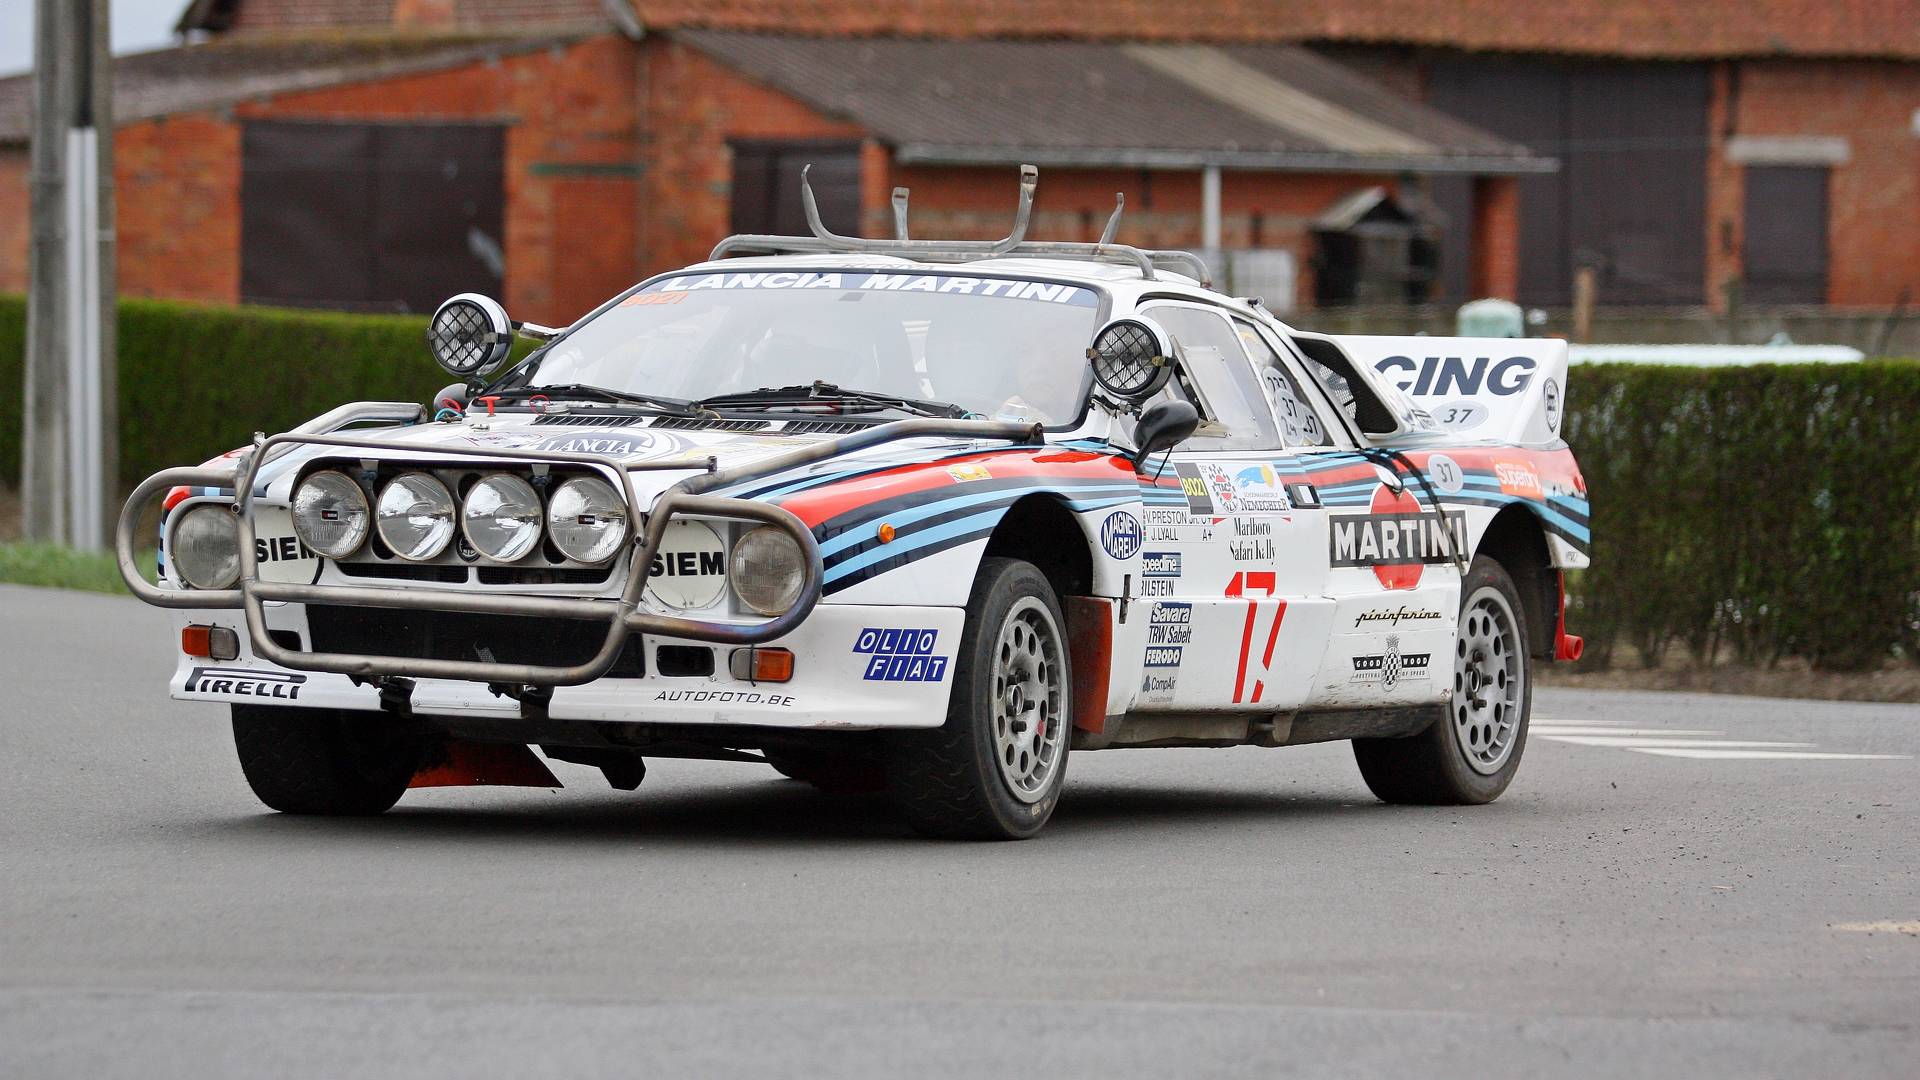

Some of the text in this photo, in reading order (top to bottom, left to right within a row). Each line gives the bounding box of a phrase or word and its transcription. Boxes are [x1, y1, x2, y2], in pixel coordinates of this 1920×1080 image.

[661, 272, 1078, 303] LANCIA MARTINI
[1443, 408, 1473, 424] 37
[543, 439, 632, 454] LANCIA
[1435, 462, 1455, 483] 37
[1145, 510, 1187, 525] V.PRESTON
[1234, 517, 1271, 536] Marlboro
[1151, 528, 1213, 541] J.LYALL A+
[1334, 516, 1464, 561] MARTINI
[1230, 540, 1253, 561] Safari
[649, 552, 724, 577] SIEM
[1152, 602, 1190, 623] Savara
[1355, 605, 1442, 628] pininfarina
[859, 630, 934, 651] OLIO
[1149, 625, 1192, 643] TRW Sabelt
[1145, 649, 1180, 664] FERODO
[1356, 657, 1428, 668] GOOD WOOD
[868, 658, 944, 679] FIAT
[184, 667, 308, 700] PIRELLI
[1151, 676, 1176, 692] CompAir
[654, 690, 796, 707] AUTOFOTO.BE
